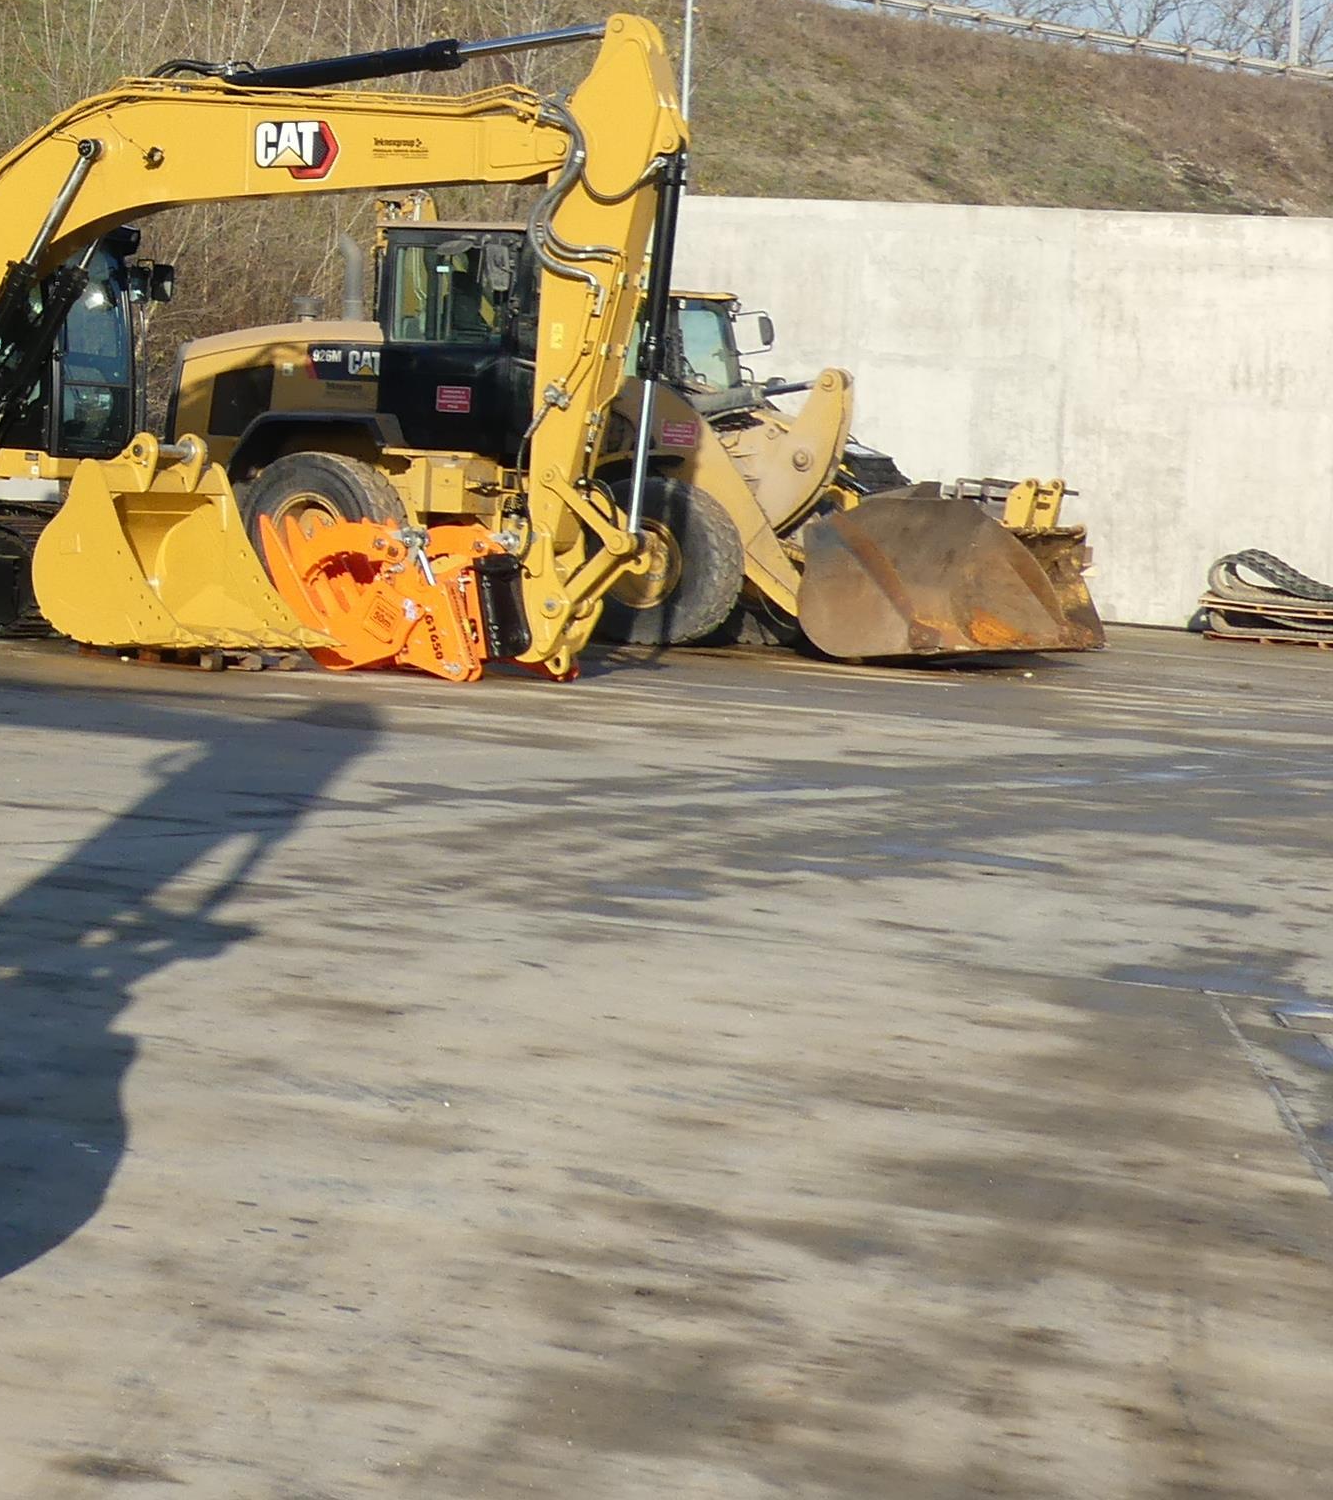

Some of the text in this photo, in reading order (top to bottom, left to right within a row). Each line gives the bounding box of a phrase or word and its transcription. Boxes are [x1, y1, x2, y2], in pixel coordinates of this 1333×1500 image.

[255, 122, 319, 167] CAT
[313, 349, 342, 362] 926M
[348, 350, 381, 377] CAT
